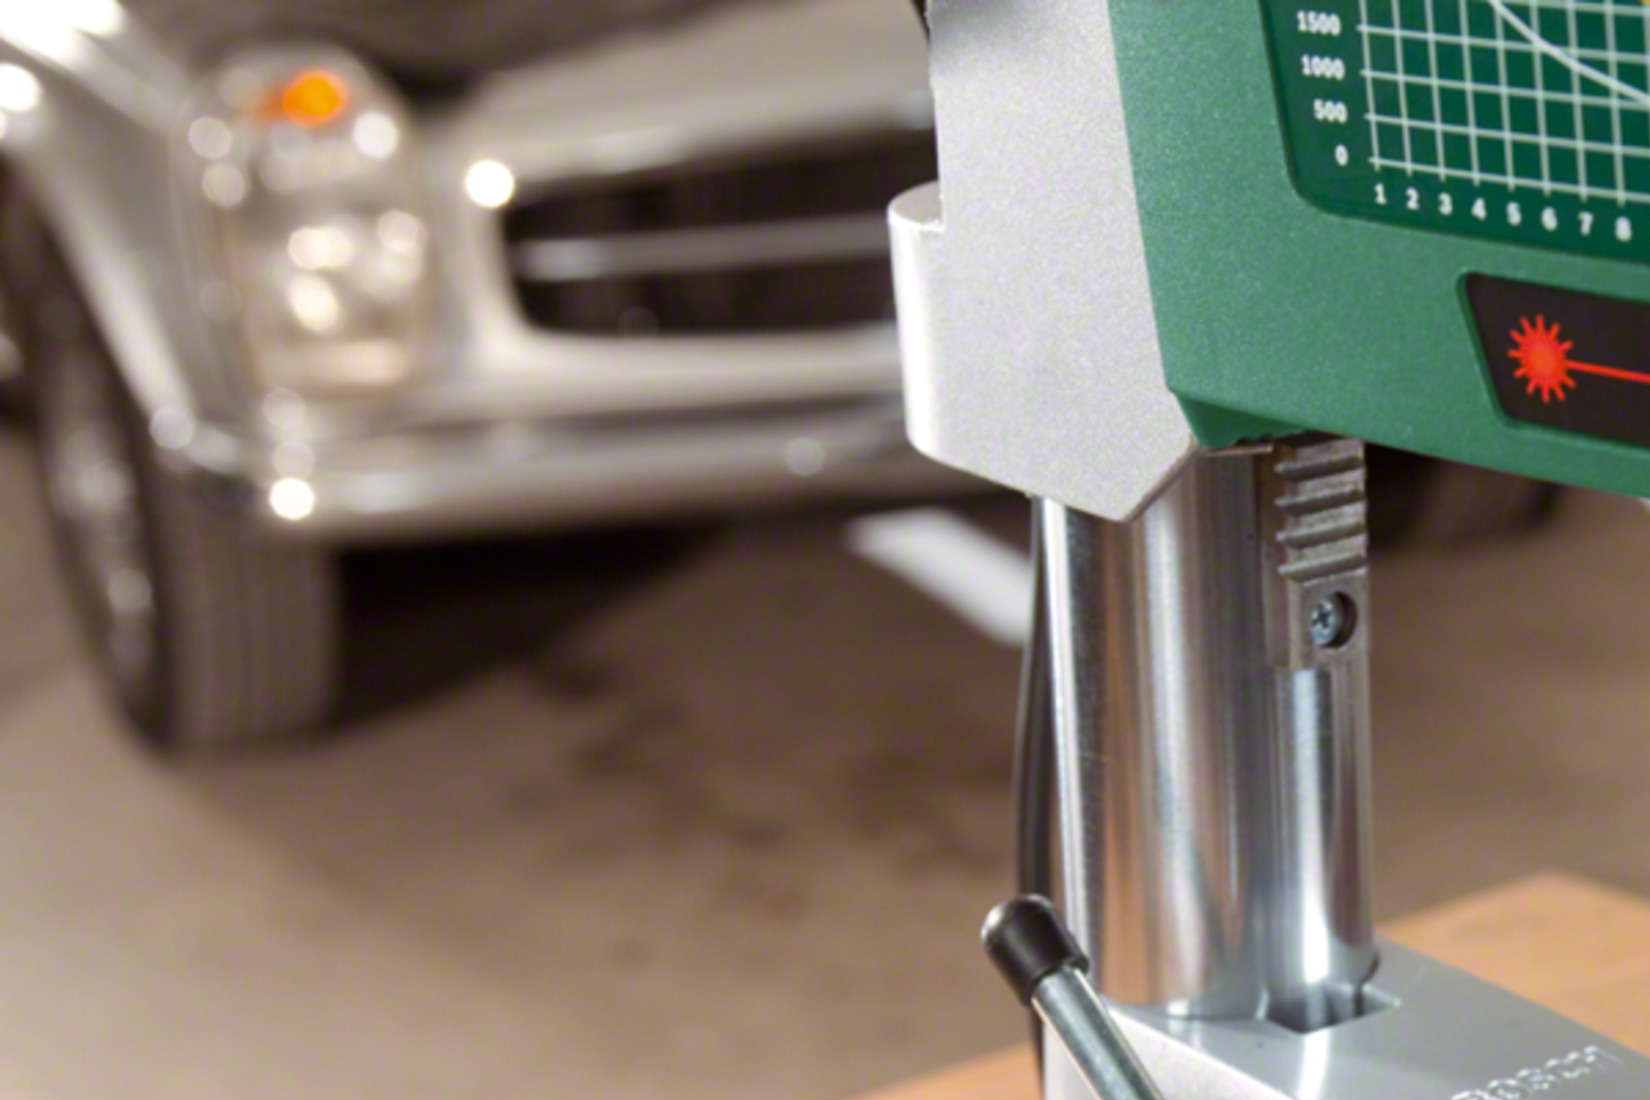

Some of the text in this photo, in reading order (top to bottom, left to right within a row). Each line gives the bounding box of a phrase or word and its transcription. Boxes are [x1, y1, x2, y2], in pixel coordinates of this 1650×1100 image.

[1297, 11, 1341, 36] 1500
[1301, 54, 1345, 80] 1000
[1313, 98, 1347, 124] 500
[1335, 144, 1348, 165] 0
[1375, 183, 1387, 205] 1
[1406, 187, 1420, 210] 2
[1439, 192, 1453, 215] 3
[1471, 197, 1487, 221] 4
[1507, 202, 1522, 226] 5
[1542, 206, 1558, 231] 6
[1578, 211, 1594, 236] 7
[1615, 216, 1632, 242] 8
